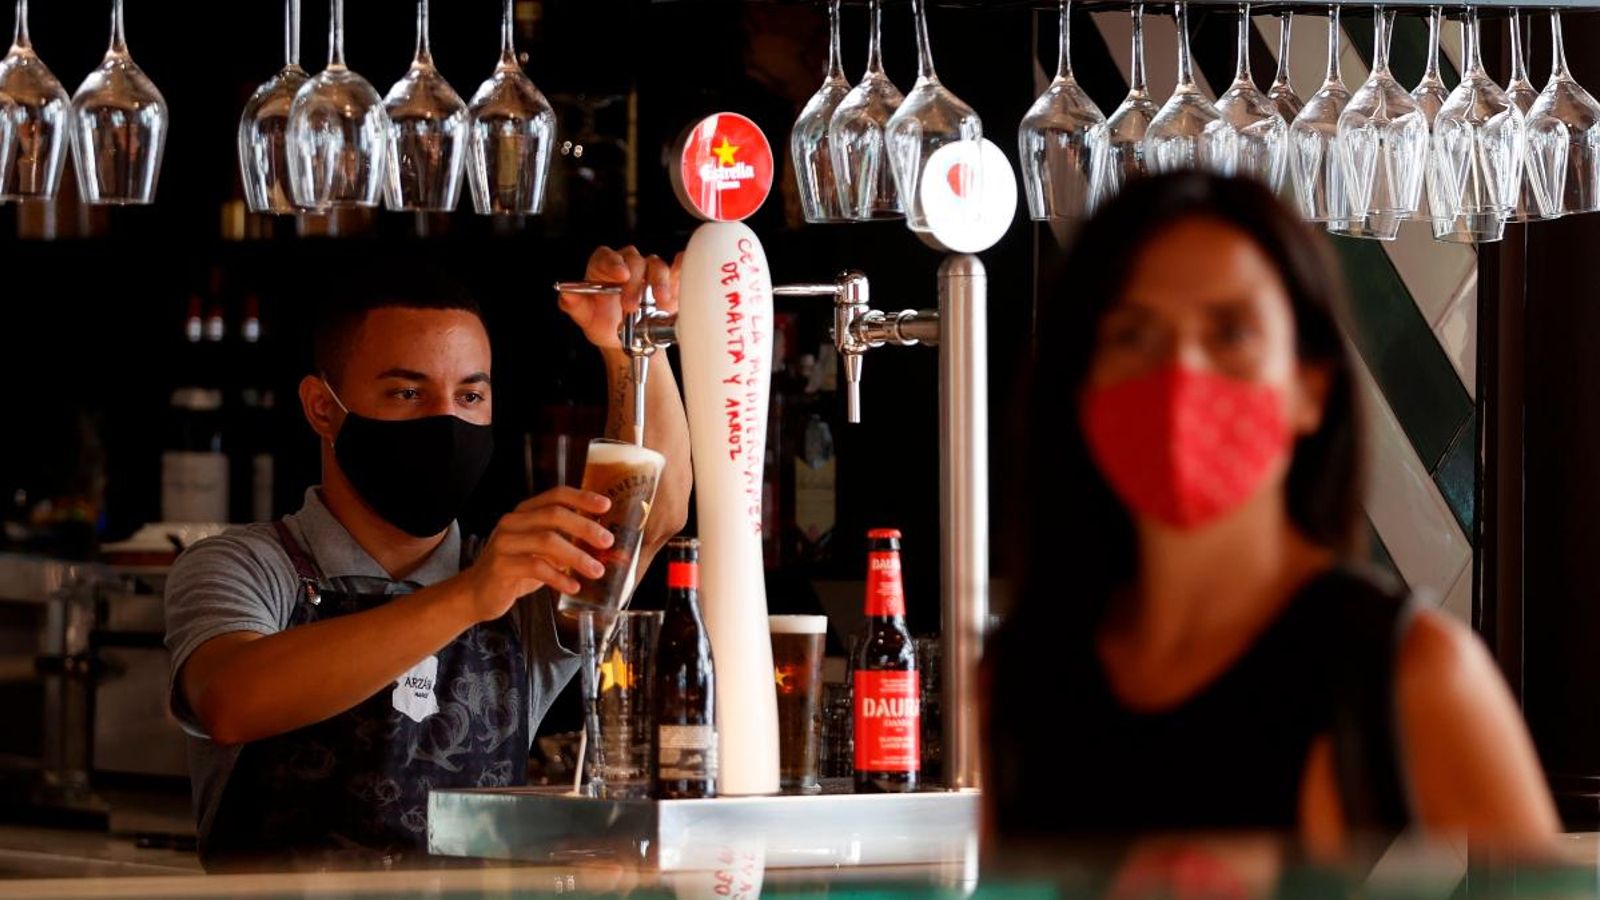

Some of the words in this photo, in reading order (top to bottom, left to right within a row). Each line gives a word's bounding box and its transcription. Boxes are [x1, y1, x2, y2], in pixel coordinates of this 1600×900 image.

[720, 261, 741, 286] DE
[725, 291, 745, 364] MALTA
[722, 374, 742, 385] Y
[725, 398, 743, 460] ARROZ
